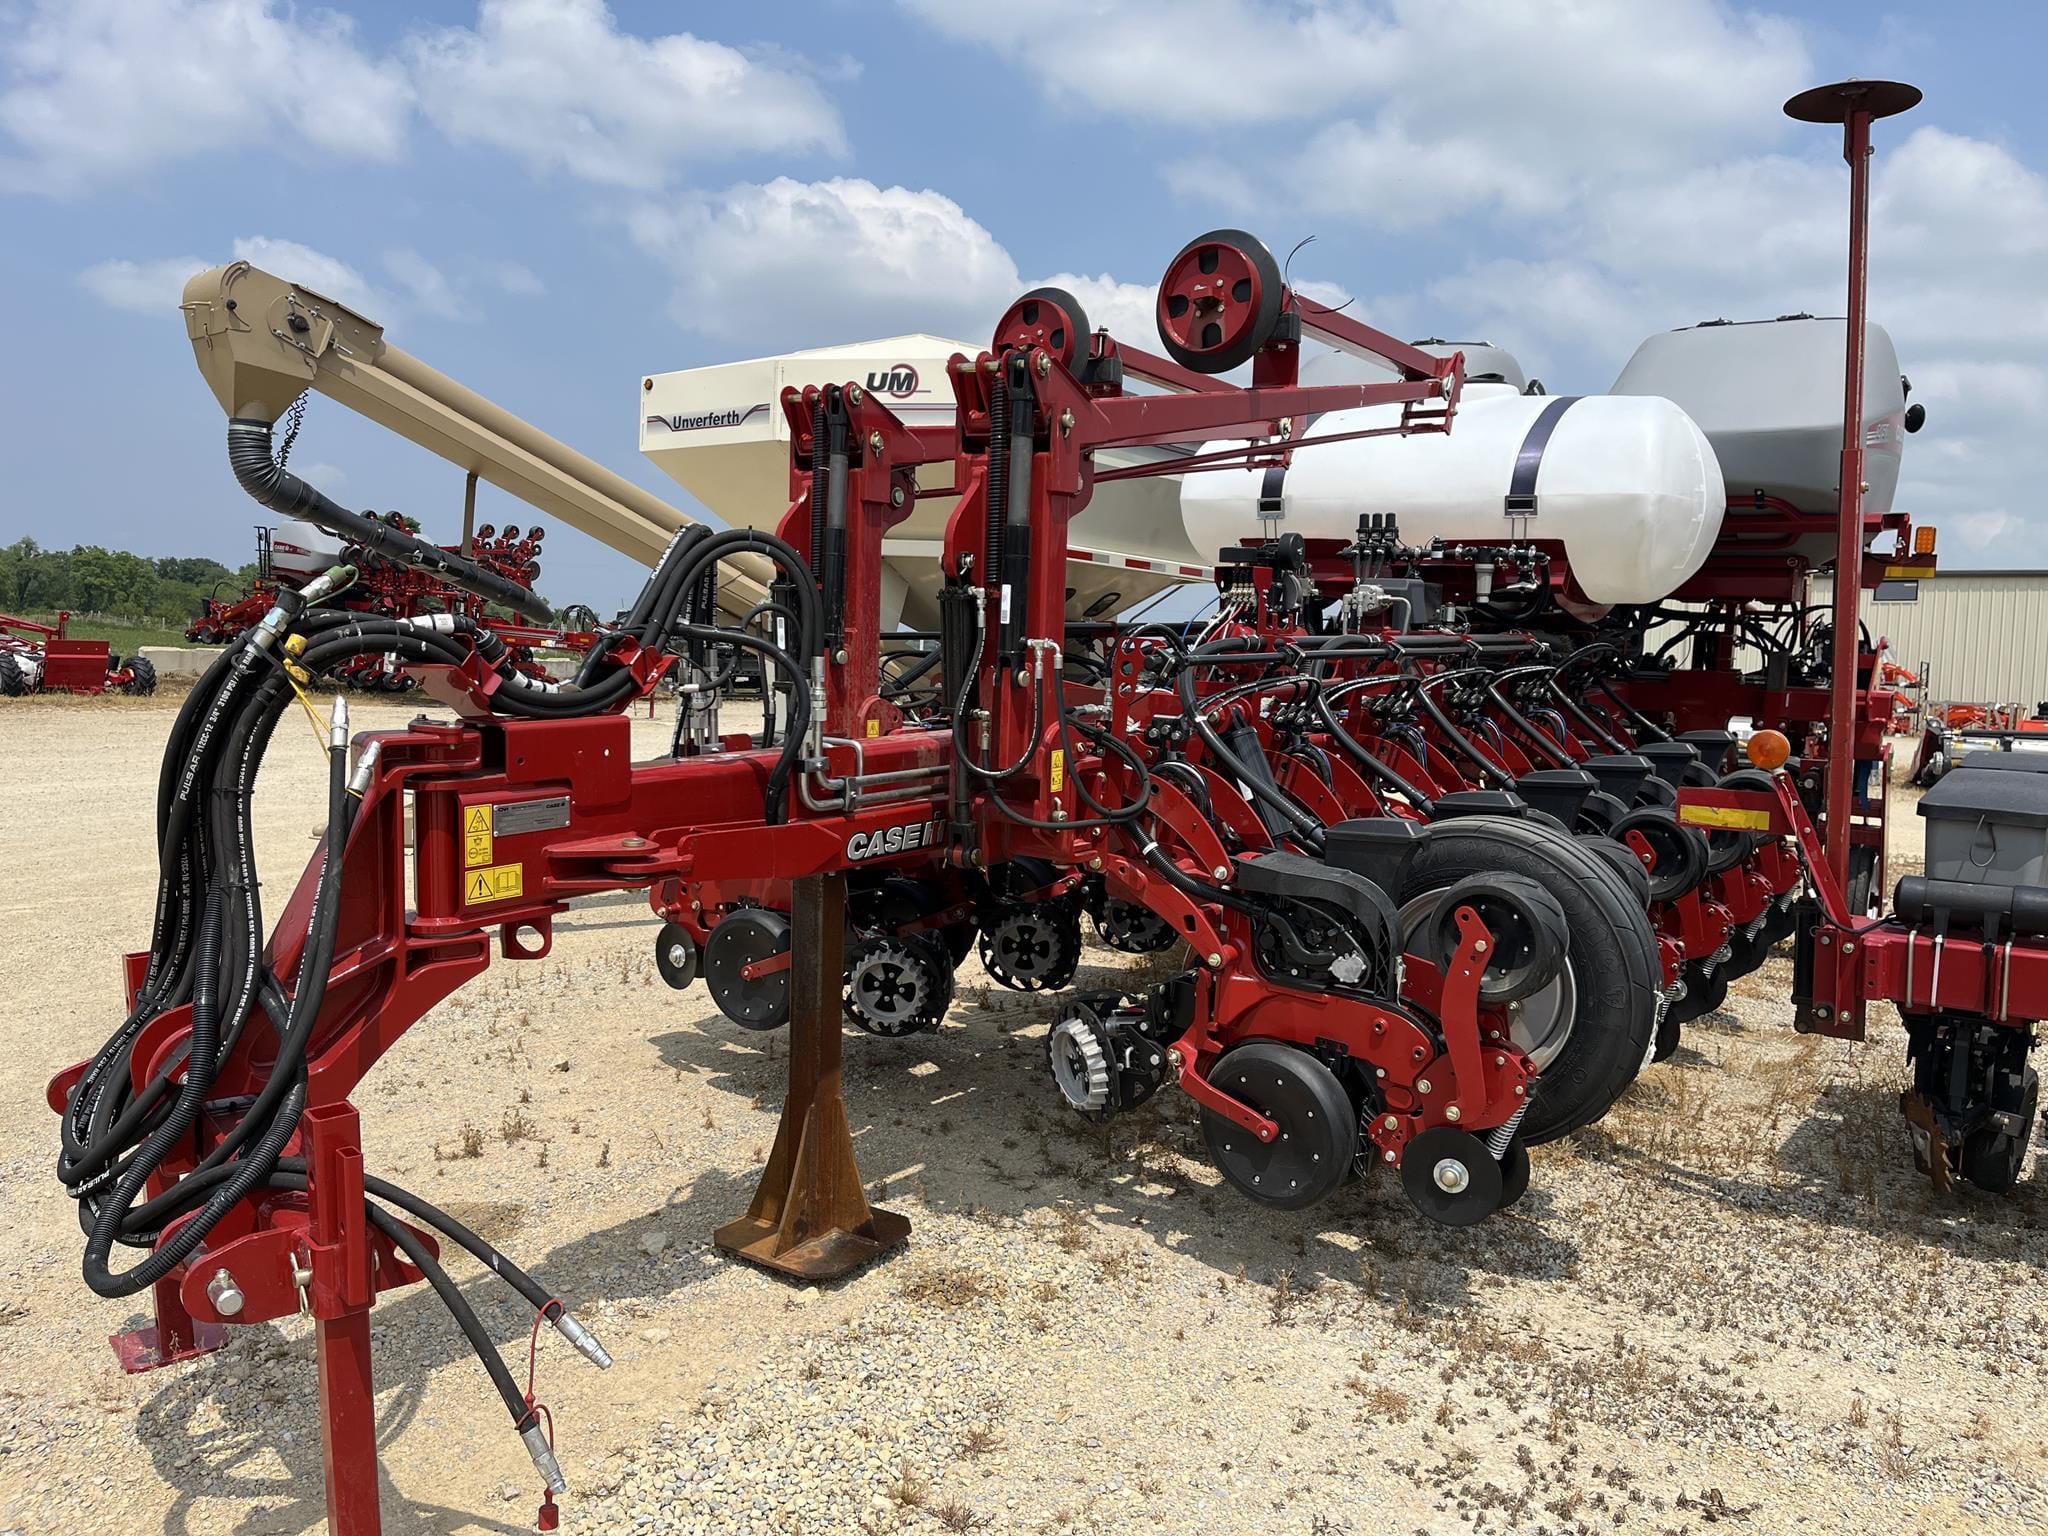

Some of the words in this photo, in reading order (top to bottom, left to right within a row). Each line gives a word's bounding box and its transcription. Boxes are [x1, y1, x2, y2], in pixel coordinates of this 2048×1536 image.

[866, 372, 915, 391] UM
[672, 410, 740, 430] Unverferth
[180, 754, 201, 800] PULSAR
[196, 723, 214, 753] 112CC-12
[217, 690, 232, 707] 3100
[226, 680, 238, 692] PSI
[847, 823, 922, 860] CASE
